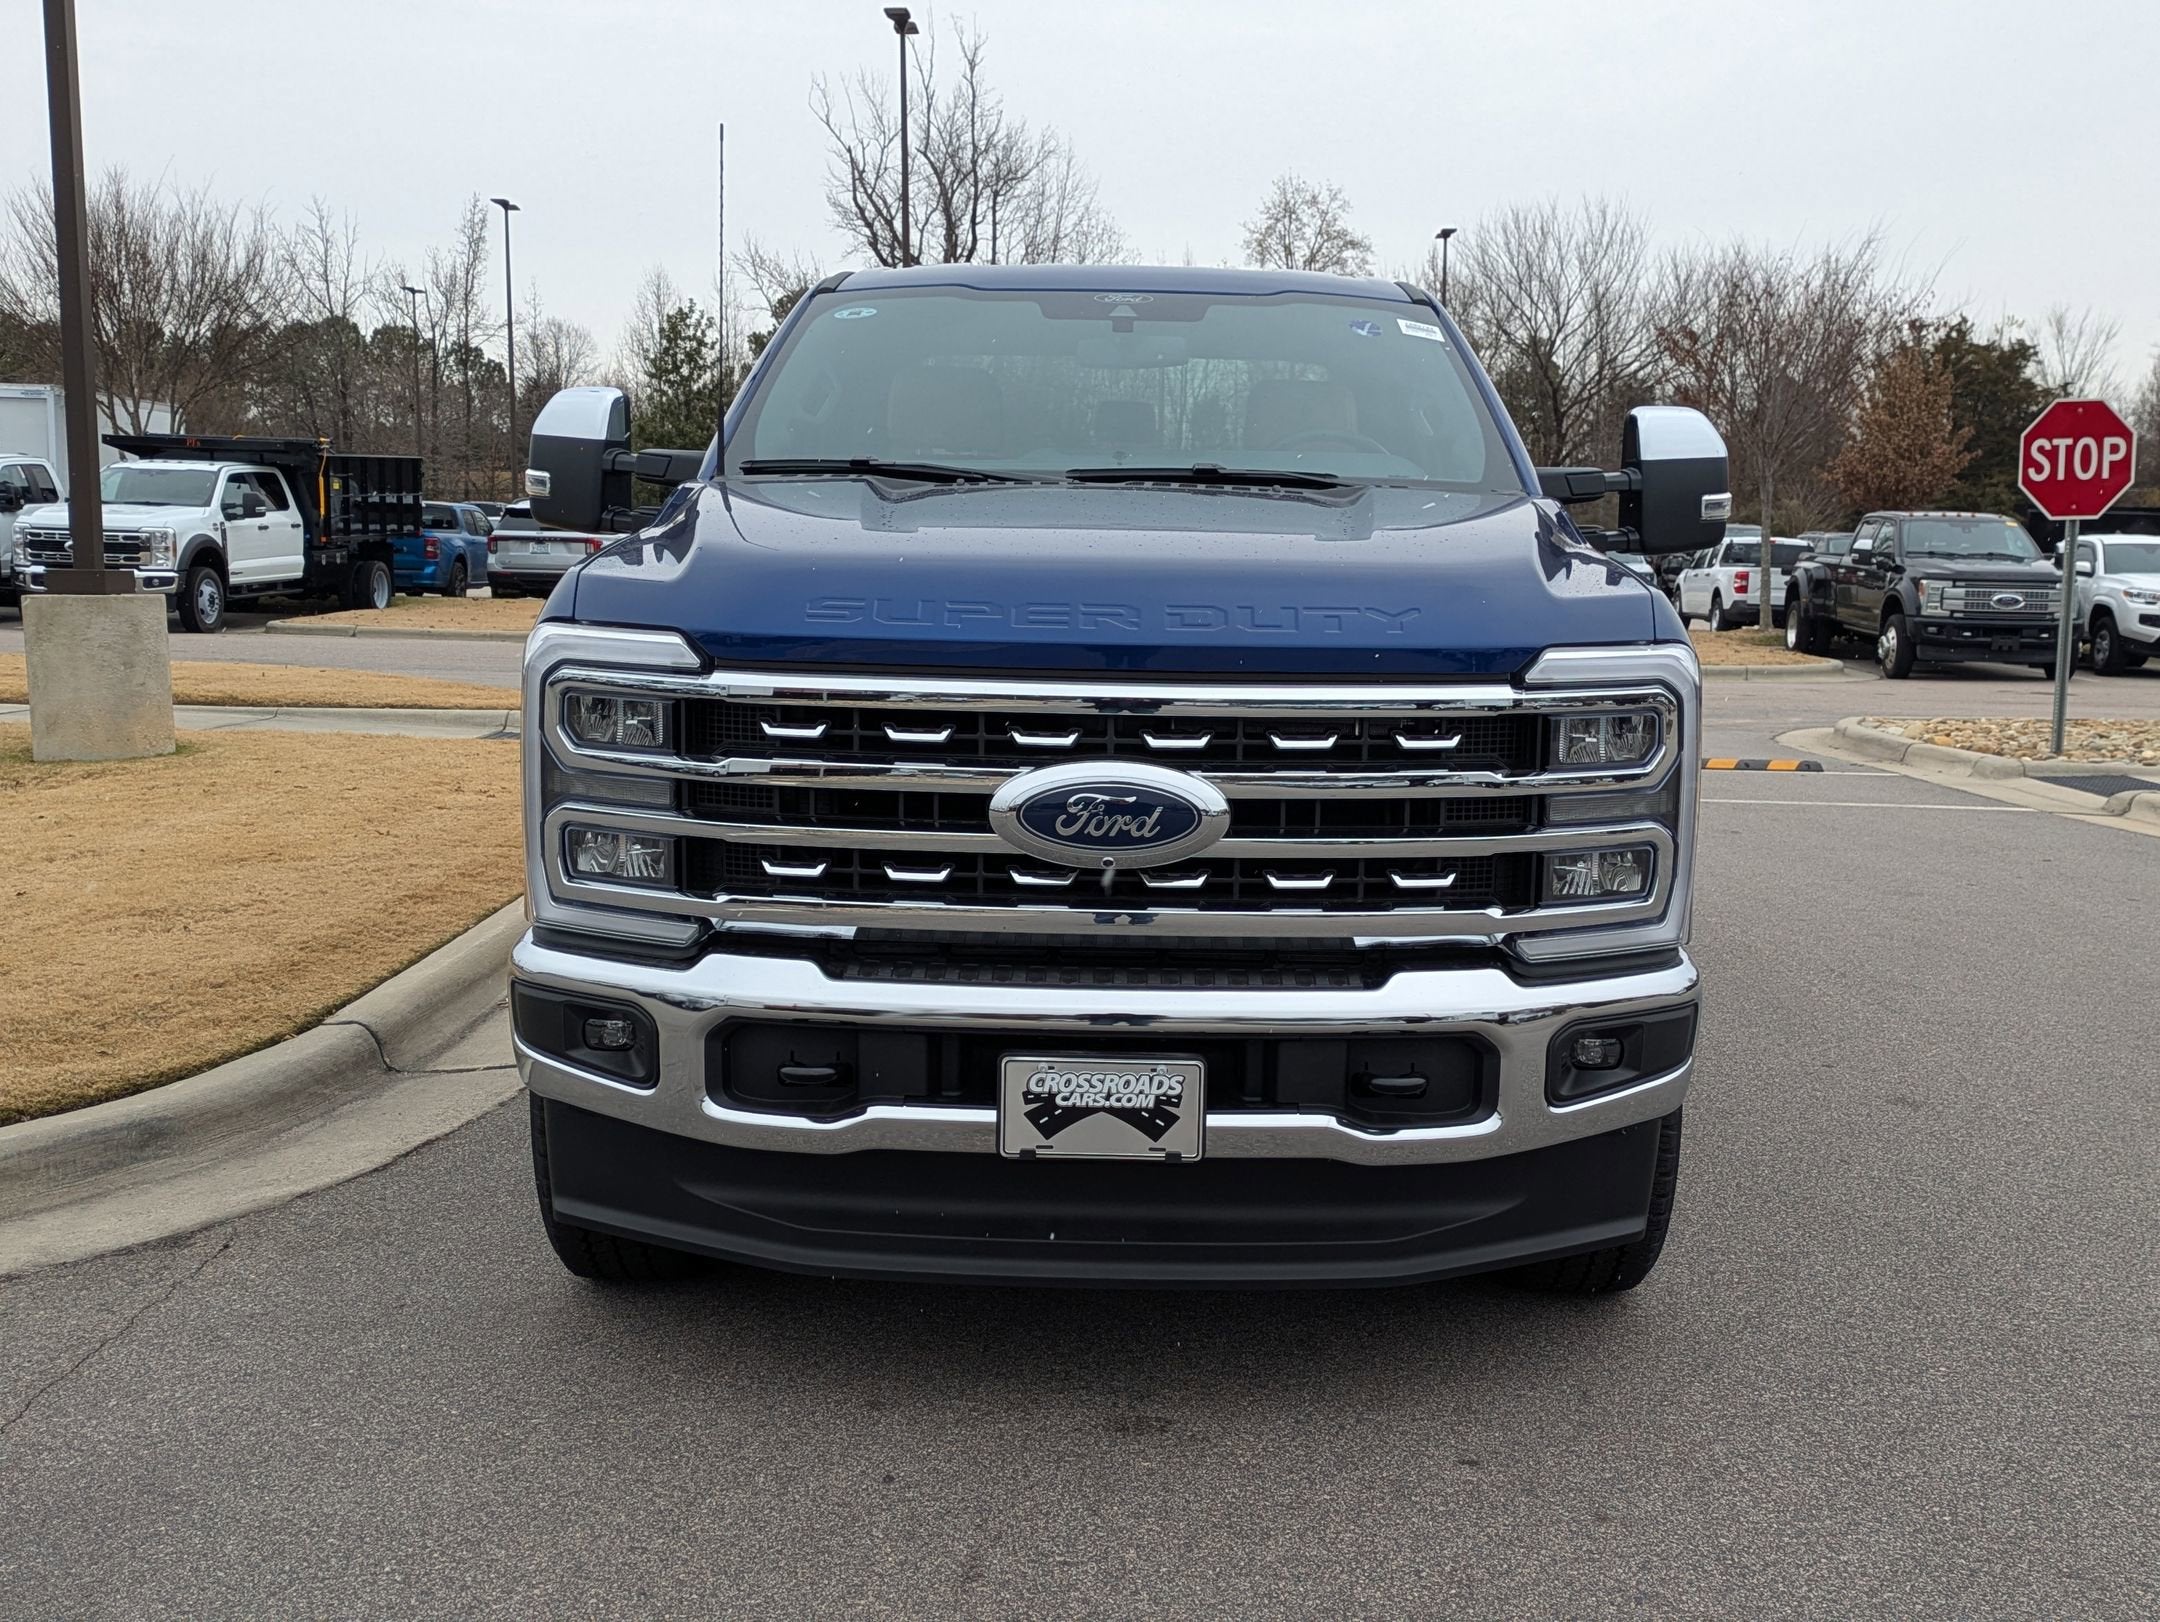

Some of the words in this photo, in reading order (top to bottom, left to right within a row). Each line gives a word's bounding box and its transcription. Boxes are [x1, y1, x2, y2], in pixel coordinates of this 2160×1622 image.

[2027, 436, 2127, 482] STOP
[804, 596, 1140, 631] SUPER
[1164, 603, 1422, 634] DUTY
[1055, 793, 1164, 838] Ford
[1027, 1070, 1186, 1096] CROSSROADS
[1055, 1092, 1157, 1109] CARS.COM
